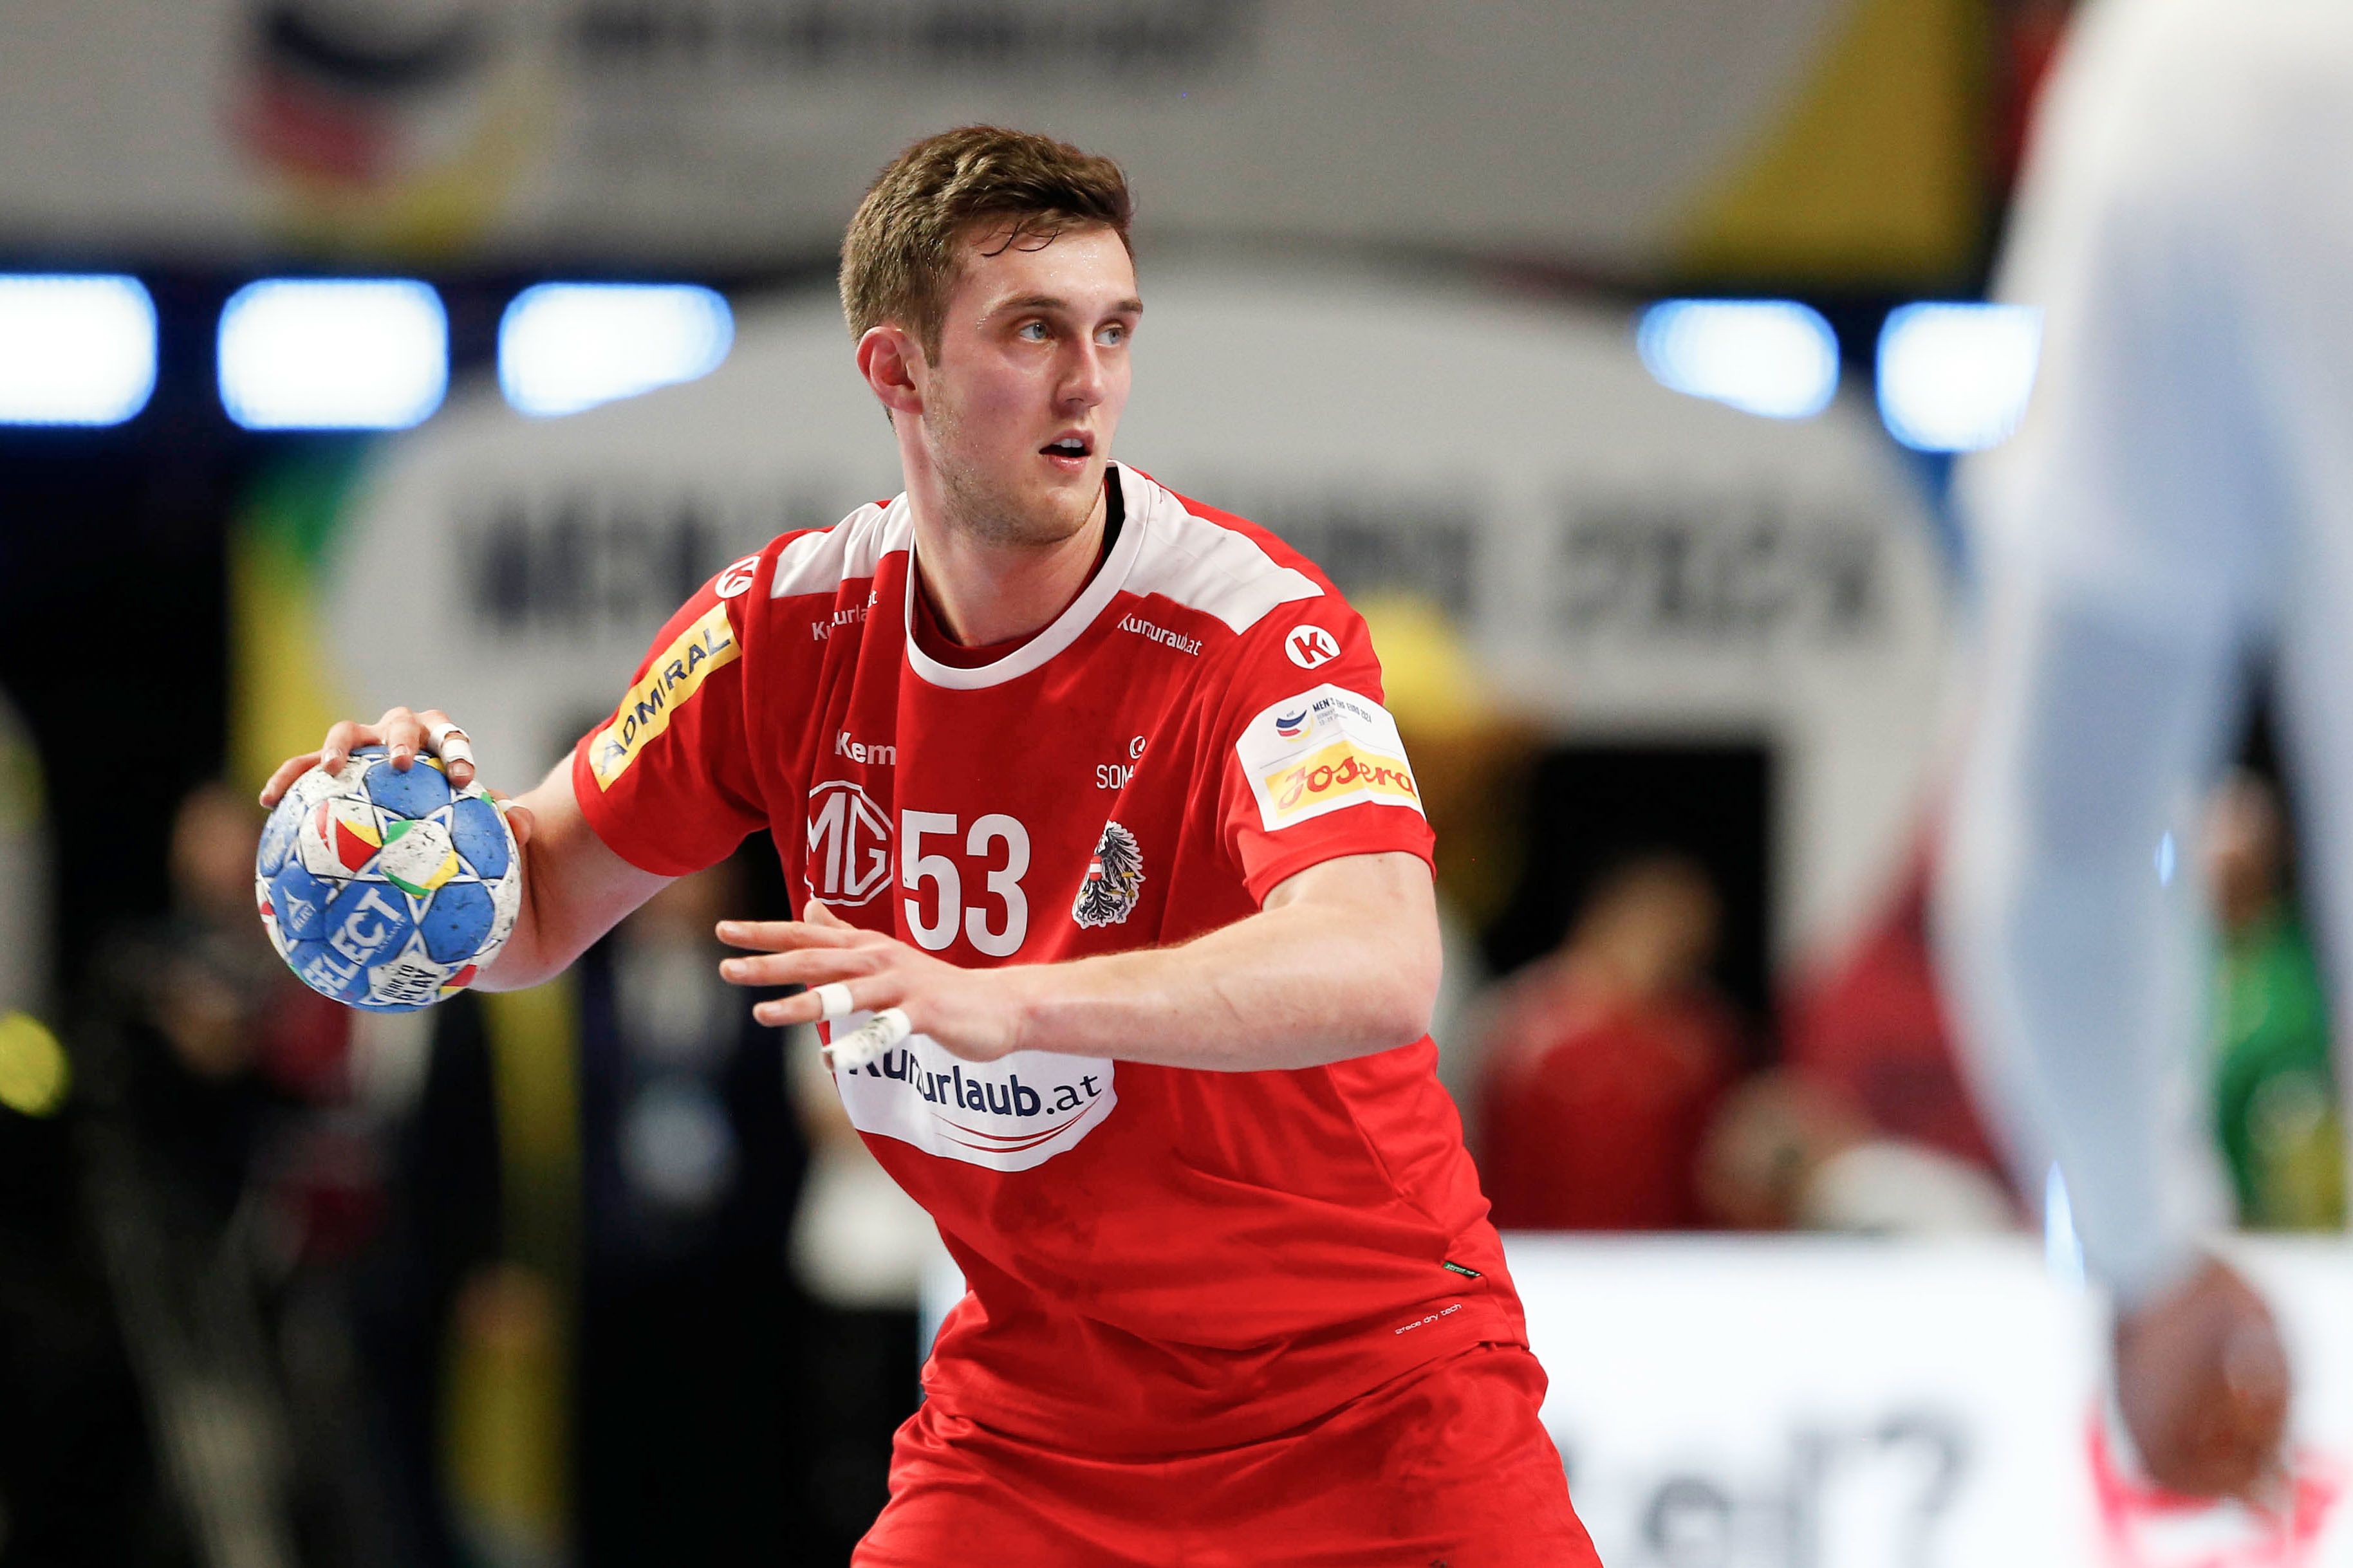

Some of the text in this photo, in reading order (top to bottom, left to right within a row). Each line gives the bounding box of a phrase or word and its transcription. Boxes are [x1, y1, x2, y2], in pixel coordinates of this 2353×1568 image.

[600, 628, 731, 776] ADMIRAL
[835, 728, 897, 766] Kem
[1096, 764, 1134, 789] SOM
[1278, 756, 1417, 809] Josera
[806, 791, 888, 897] MG
[901, 809, 1030, 957] 53
[302, 887, 403, 997] SELECT
[400, 968, 440, 1001] PLAY
[1423, 1313, 1438, 1324] dry
[1440, 1303, 1462, 1316] tech
